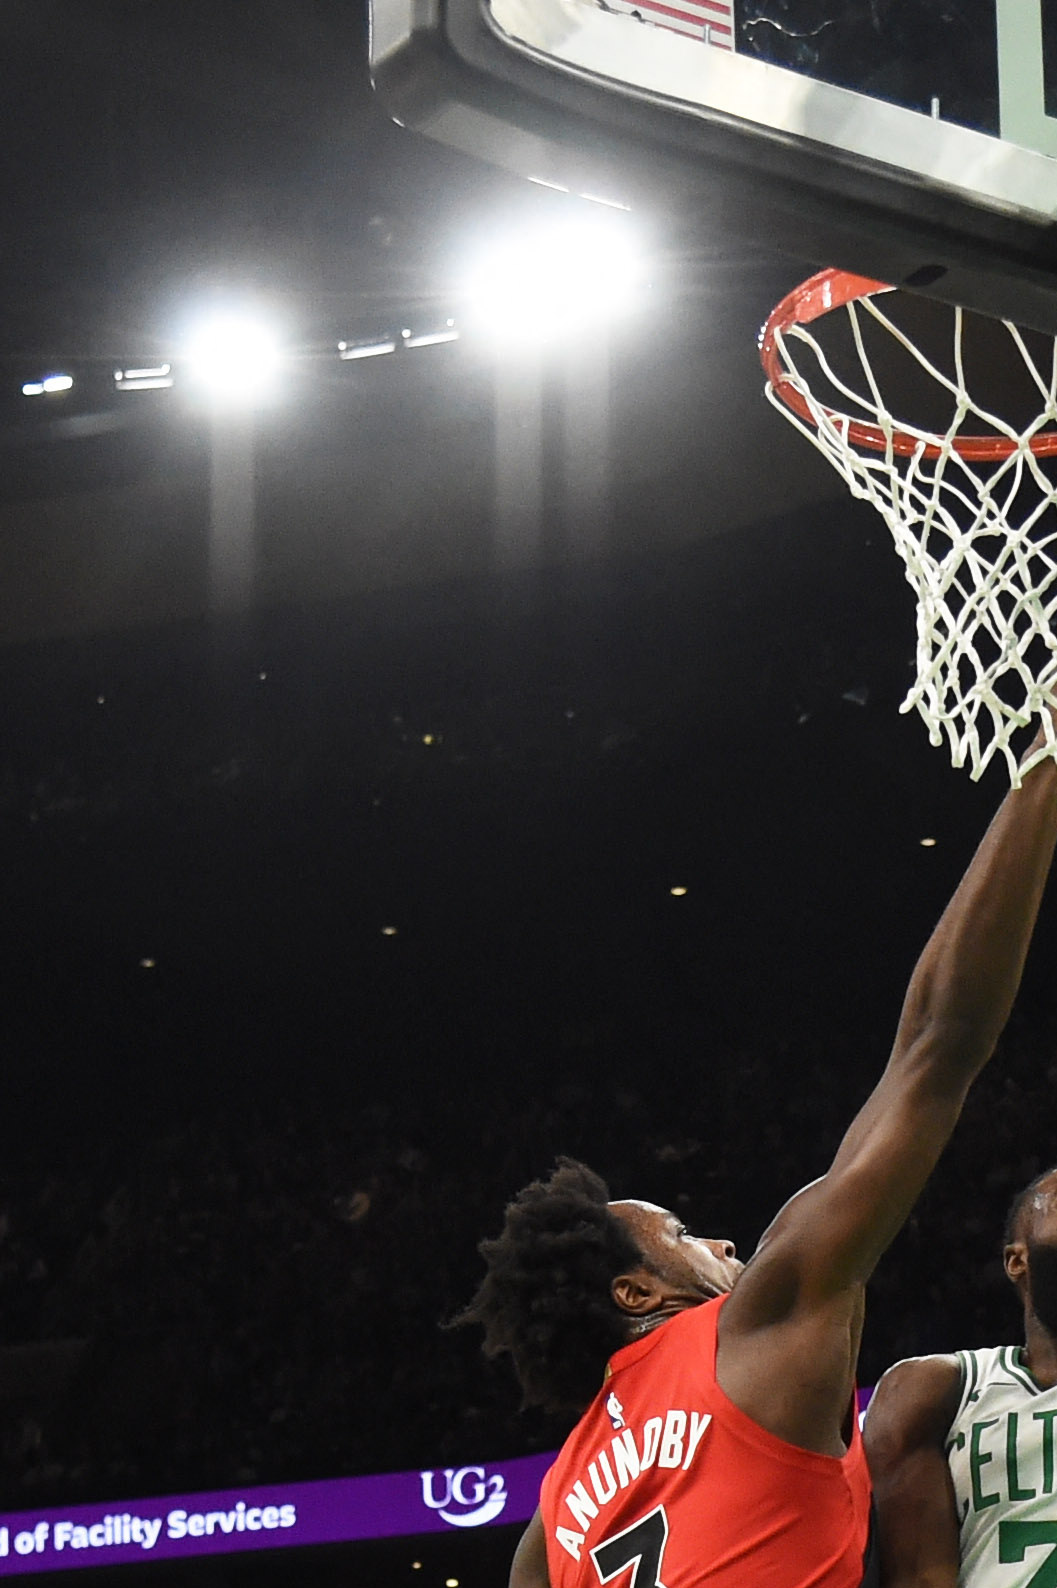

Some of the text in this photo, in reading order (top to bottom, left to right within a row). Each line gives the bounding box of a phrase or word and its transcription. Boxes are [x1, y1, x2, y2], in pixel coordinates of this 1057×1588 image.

[420, 1466, 508, 1509] UG2
[14, 1522, 49, 1555] of
[54, 1513, 162, 1549] Facility
[167, 1502, 297, 1539] Services
